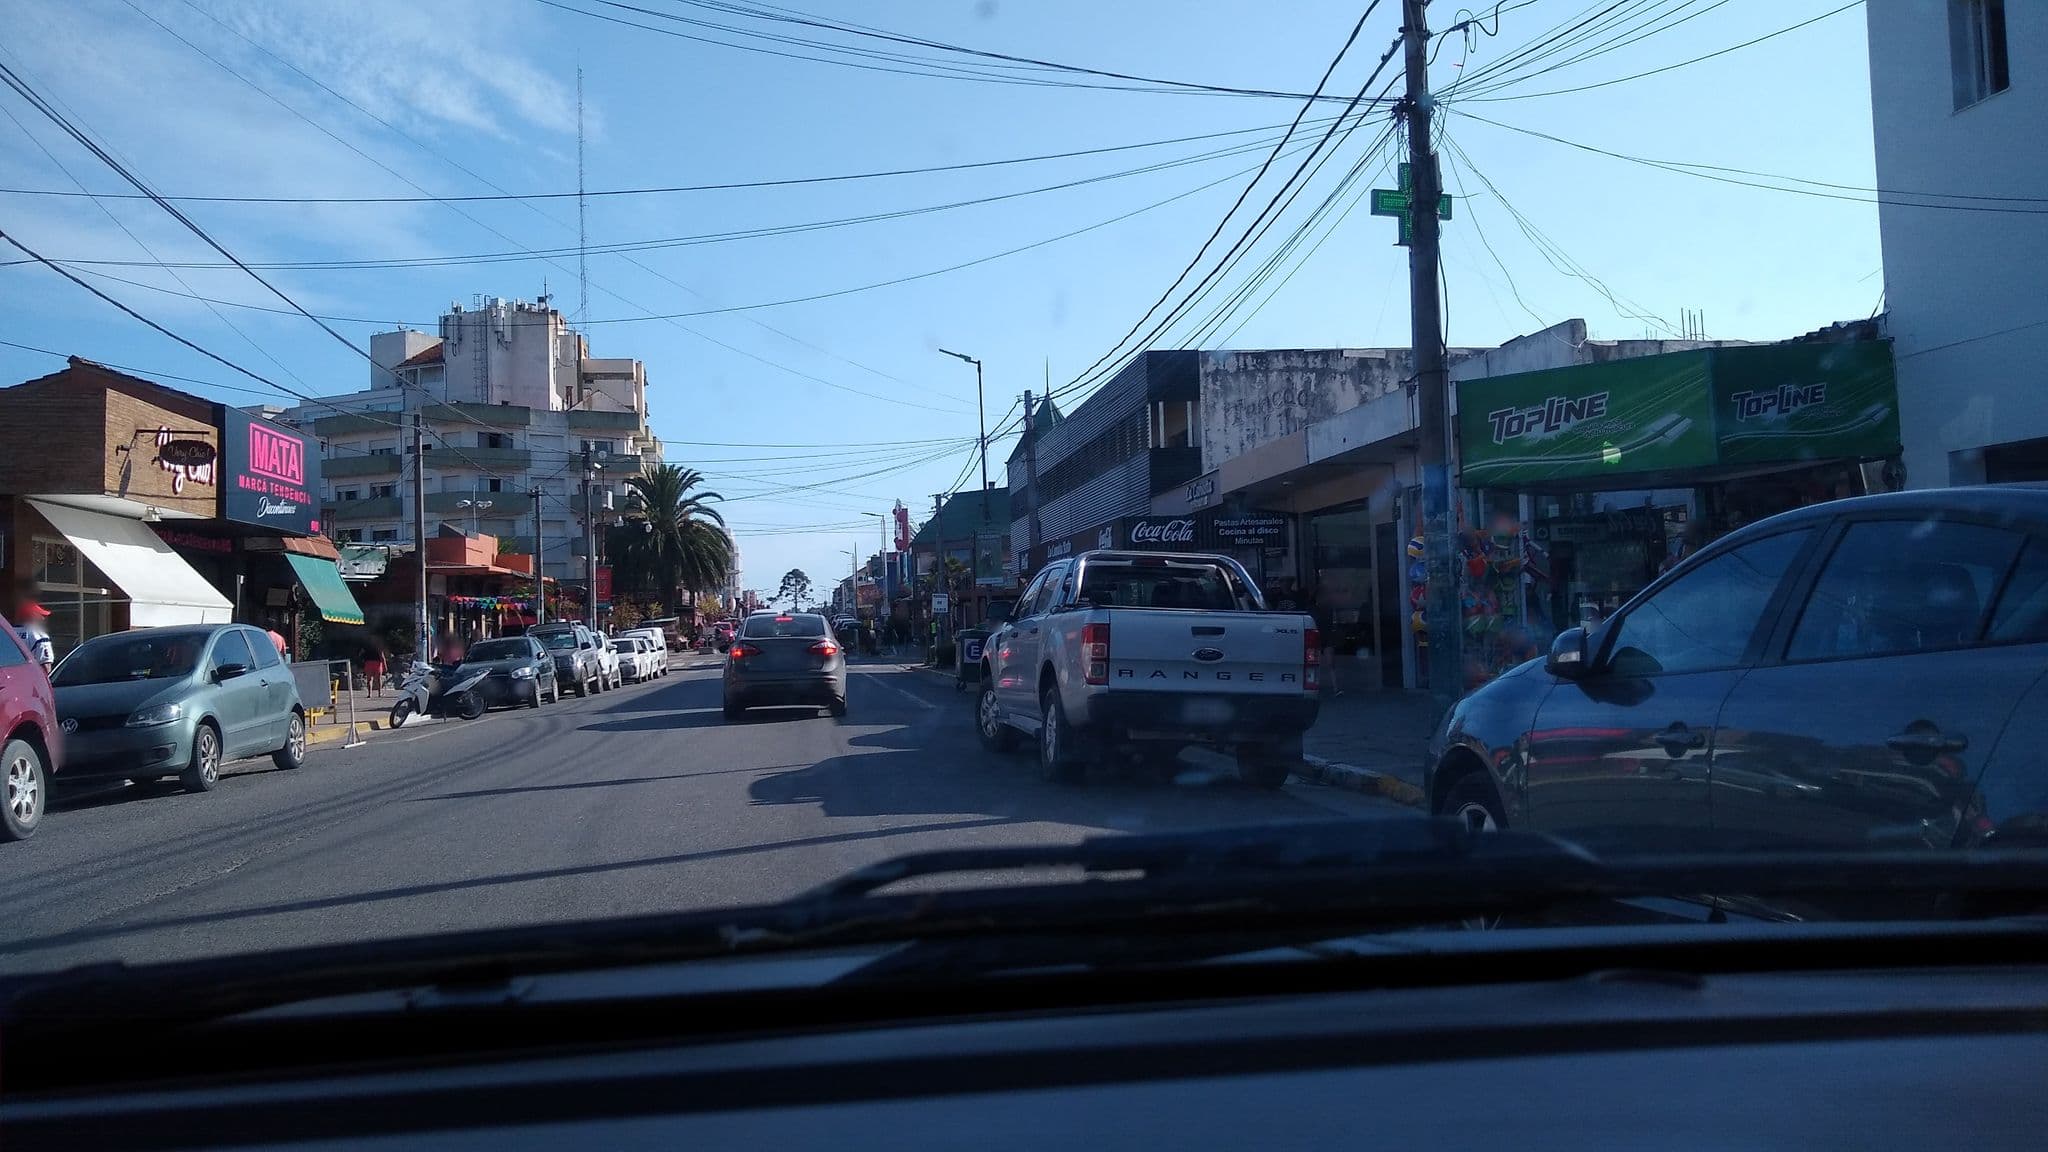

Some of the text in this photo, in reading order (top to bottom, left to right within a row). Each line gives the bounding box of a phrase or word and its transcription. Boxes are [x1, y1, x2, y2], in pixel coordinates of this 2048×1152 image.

[254, 430, 300, 480] MATA
[1213, 517, 1284, 527] Pastas Artesanales
[1218, 526, 1279, 536] Cocina al disco
[1234, 536, 1264, 545] Minutas
[970, 645, 981, 656] E
[1118, 668, 1296, 683] RANGER
